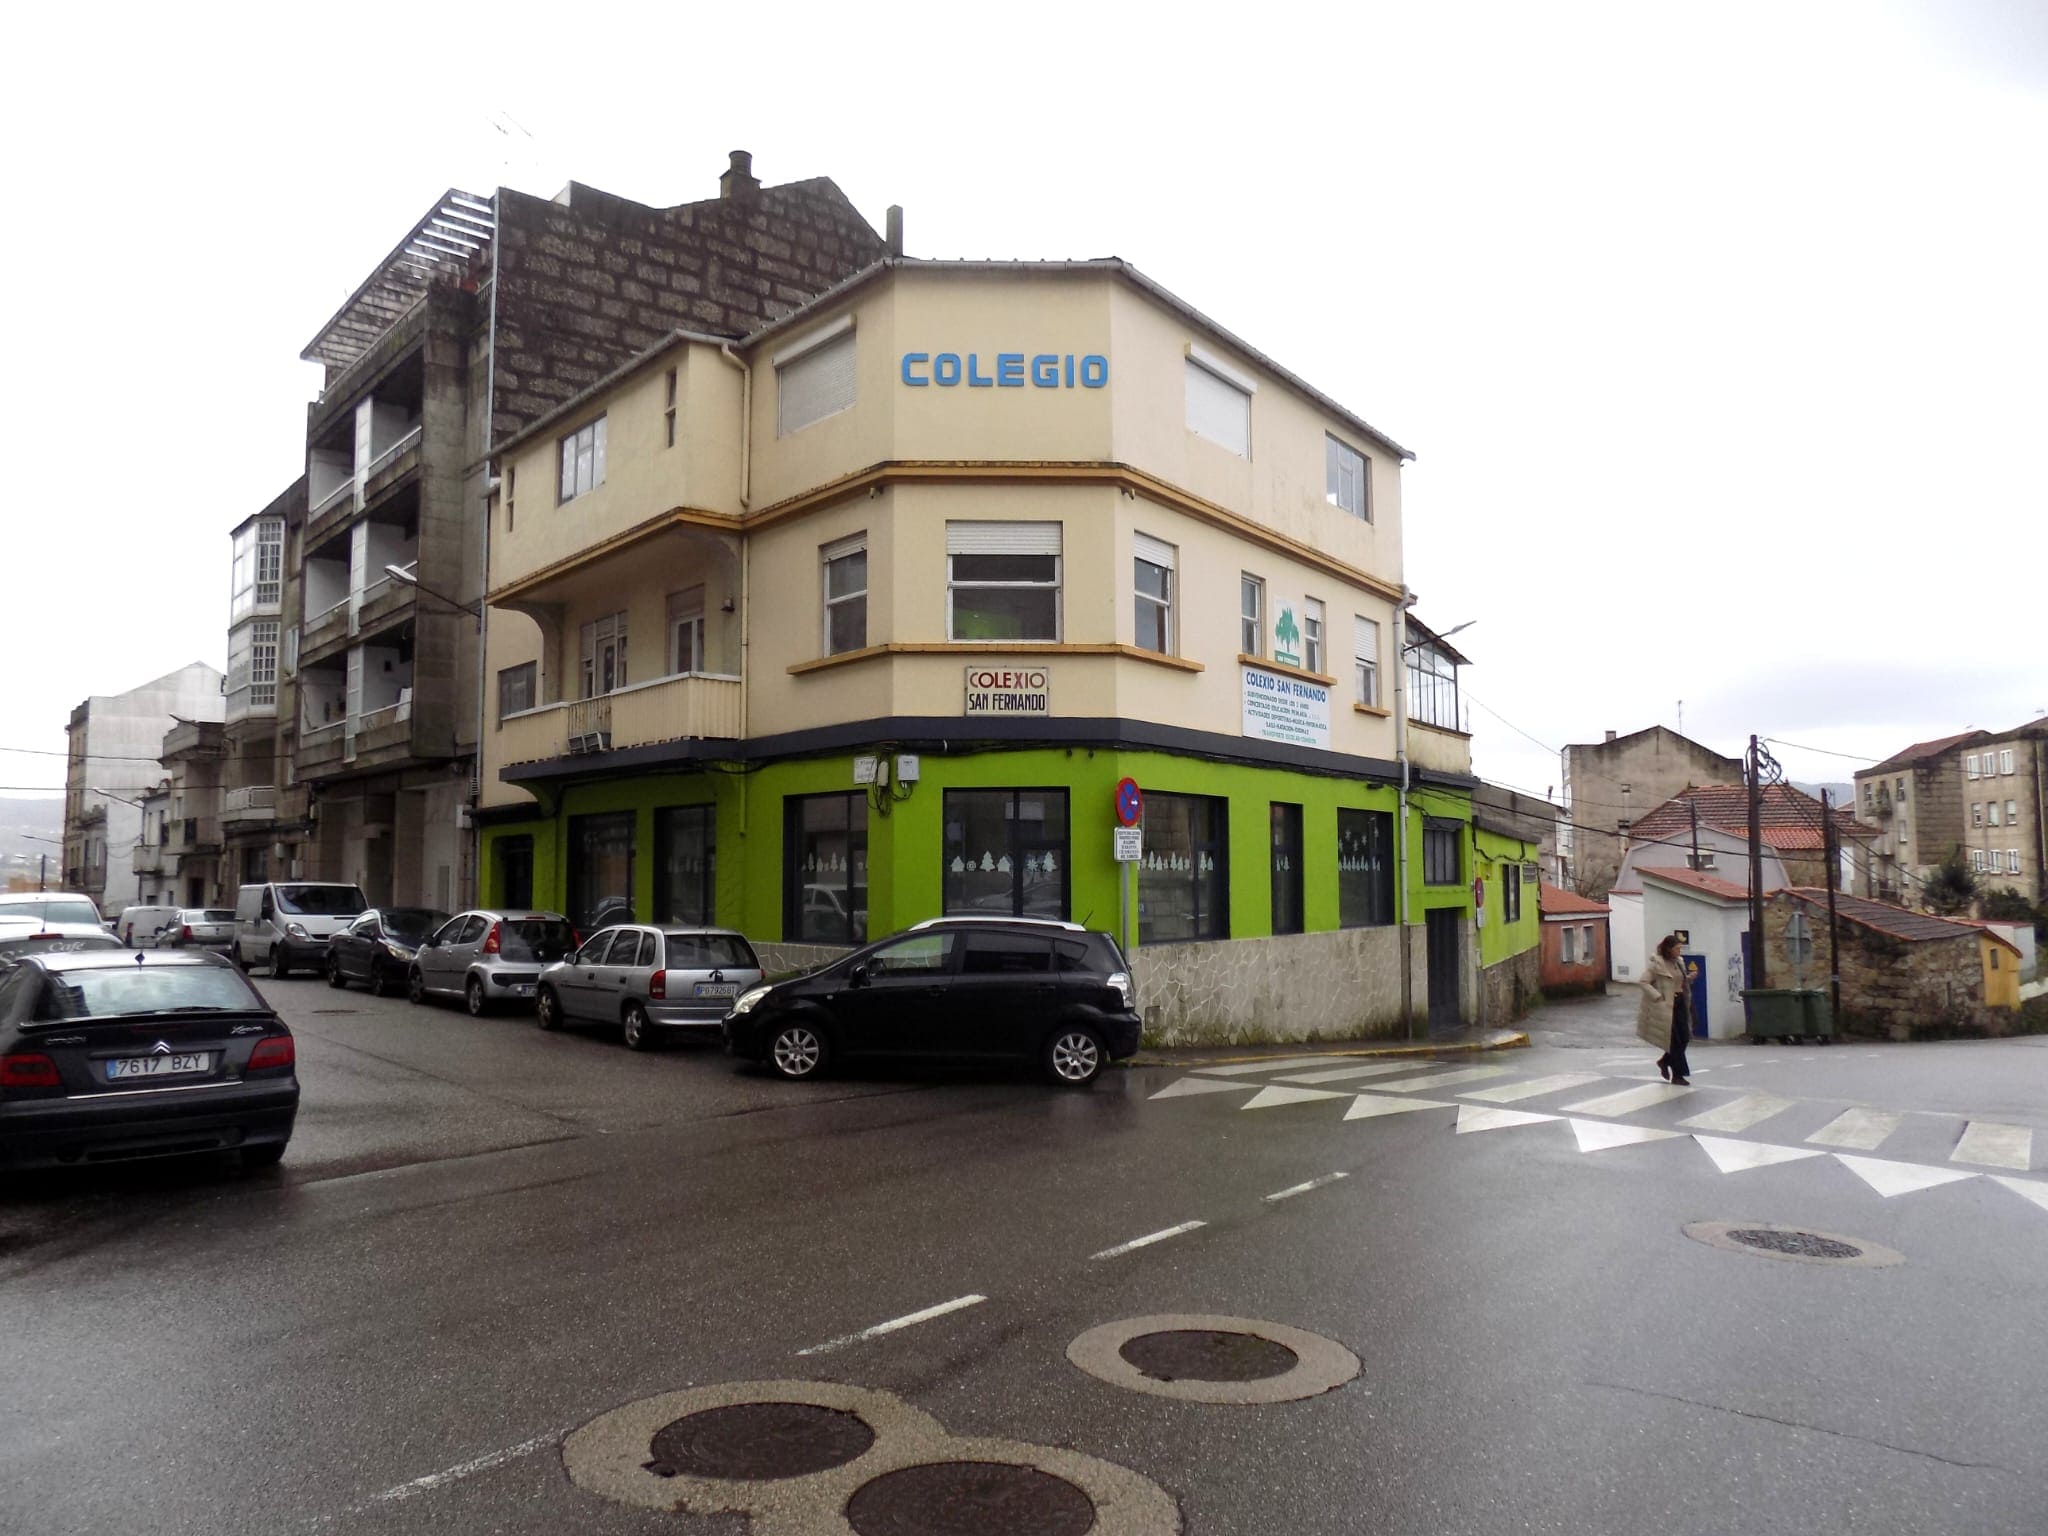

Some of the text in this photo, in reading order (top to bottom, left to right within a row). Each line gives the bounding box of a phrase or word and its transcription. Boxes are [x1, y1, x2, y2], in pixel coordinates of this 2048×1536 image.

[901, 352, 1108, 388] COLEGIO
[969, 672, 1045, 689] COLEXIO
[1246, 671, 1326, 703] COLEXIO SAN FERNANDO
[969, 693, 1045, 711] SAN FERNANDO
[118, 1055, 201, 1074] 7617 BZY
